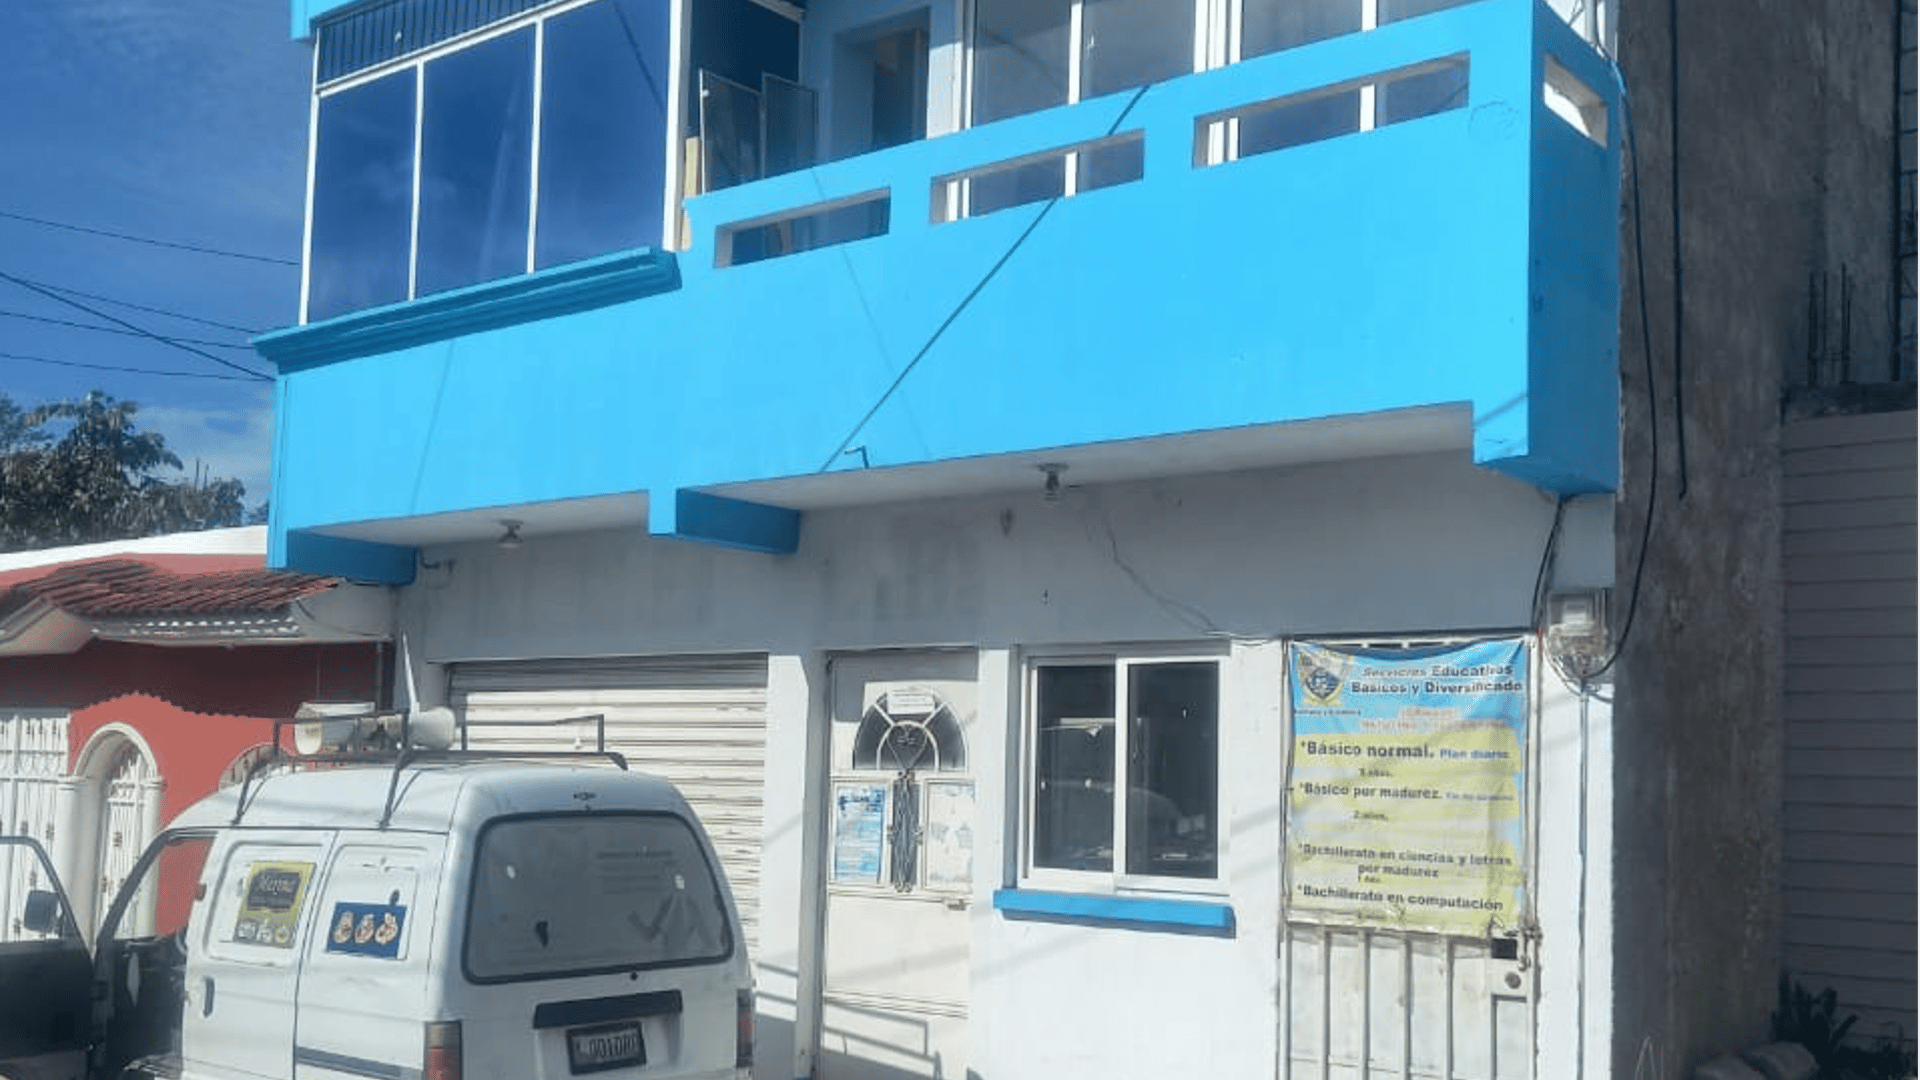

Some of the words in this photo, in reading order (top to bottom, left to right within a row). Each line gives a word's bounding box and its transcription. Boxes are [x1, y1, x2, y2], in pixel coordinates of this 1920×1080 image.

[1431, 664, 1514, 677] Educativos
[1412, 684, 1419, 695] y
[1425, 680, 1523, 693] Diversificado
[1367, 743, 1434, 758] normal.
[1379, 851, 1396, 860] en
[1458, 855, 1466, 866] y
[1470, 854, 1512, 866] letras
[1387, 893, 1404, 904] en
